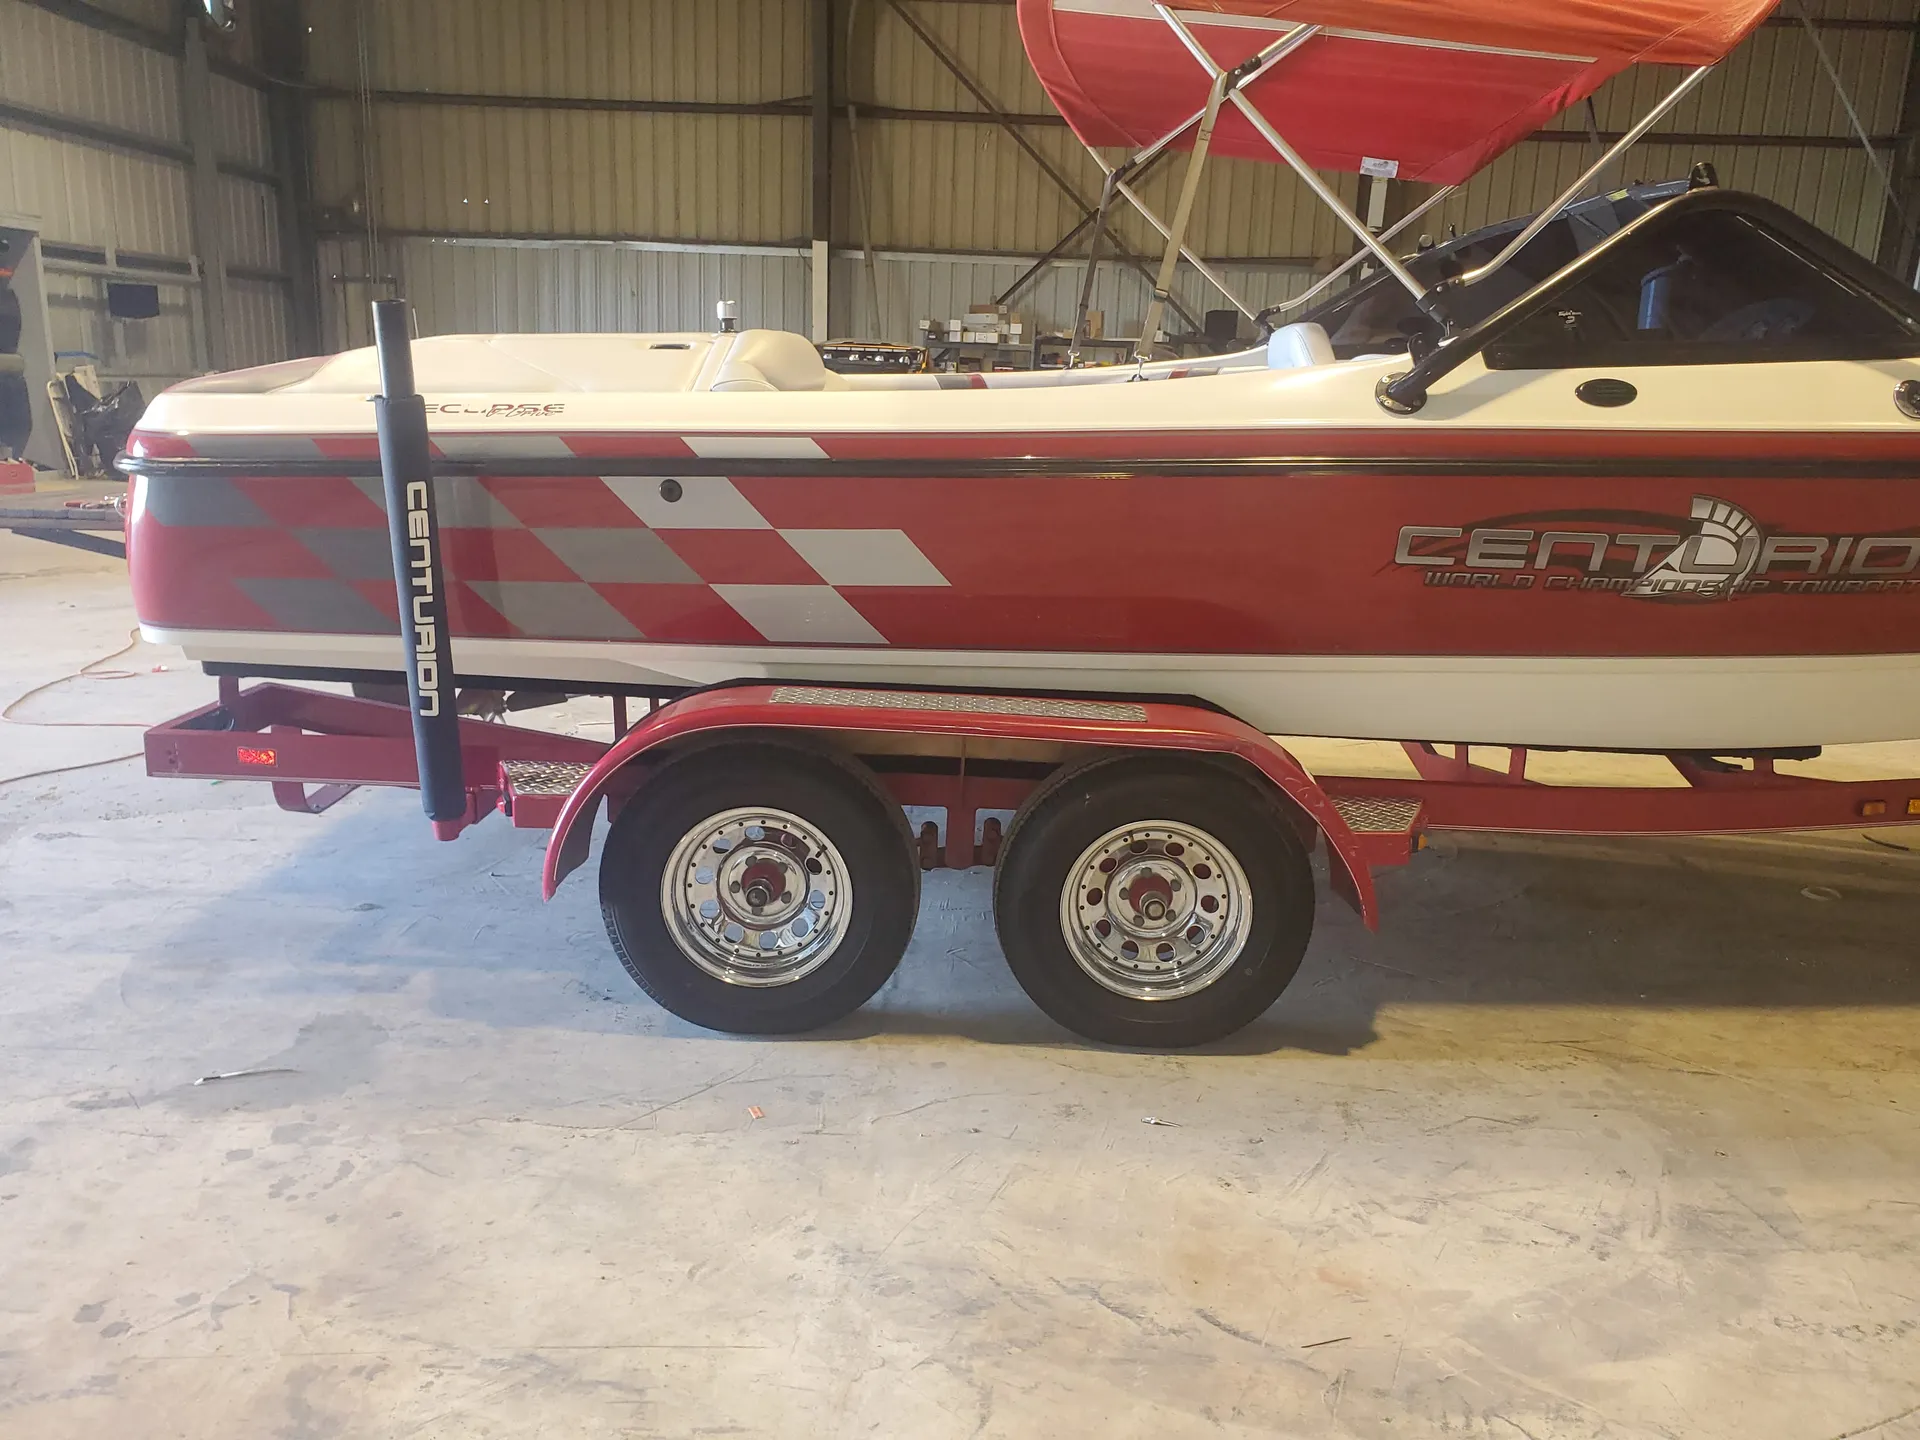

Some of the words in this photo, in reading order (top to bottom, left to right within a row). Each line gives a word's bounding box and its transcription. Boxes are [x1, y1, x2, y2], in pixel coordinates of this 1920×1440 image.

[406, 481, 439, 717] CENTURION
[1424, 571, 1536, 587] WORLD
[1543, 576, 1770, 593] CHAMPIONSHIP
